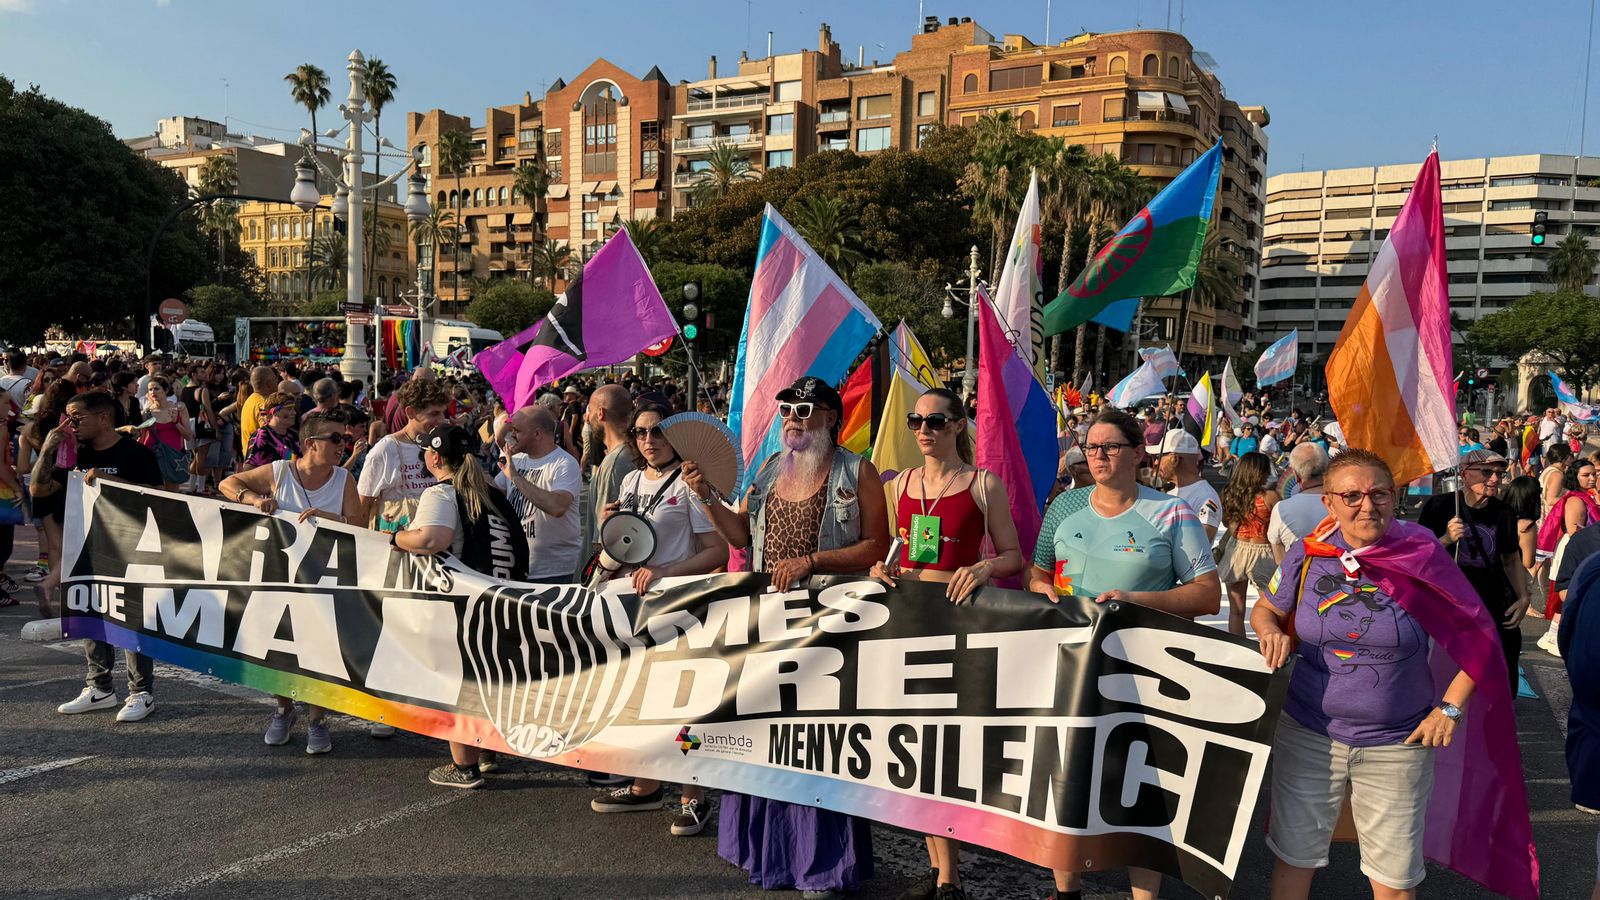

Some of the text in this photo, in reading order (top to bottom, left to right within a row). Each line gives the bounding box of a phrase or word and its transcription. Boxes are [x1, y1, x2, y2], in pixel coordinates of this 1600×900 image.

[69, 484, 359, 587] ARA
[487, 513, 516, 581] PUMA
[910, 516, 920, 559] Voluntariado
[67, 584, 464, 706] QUE MAI
[468, 585, 632, 747] ORGULL
[638, 626, 1273, 724] DRETS
[1357, 648, 1395, 660] Pride
[507, 723, 565, 758] 2025
[703, 732, 753, 748] lambda
[768, 721, 1253, 866] MENYS SILENCI
